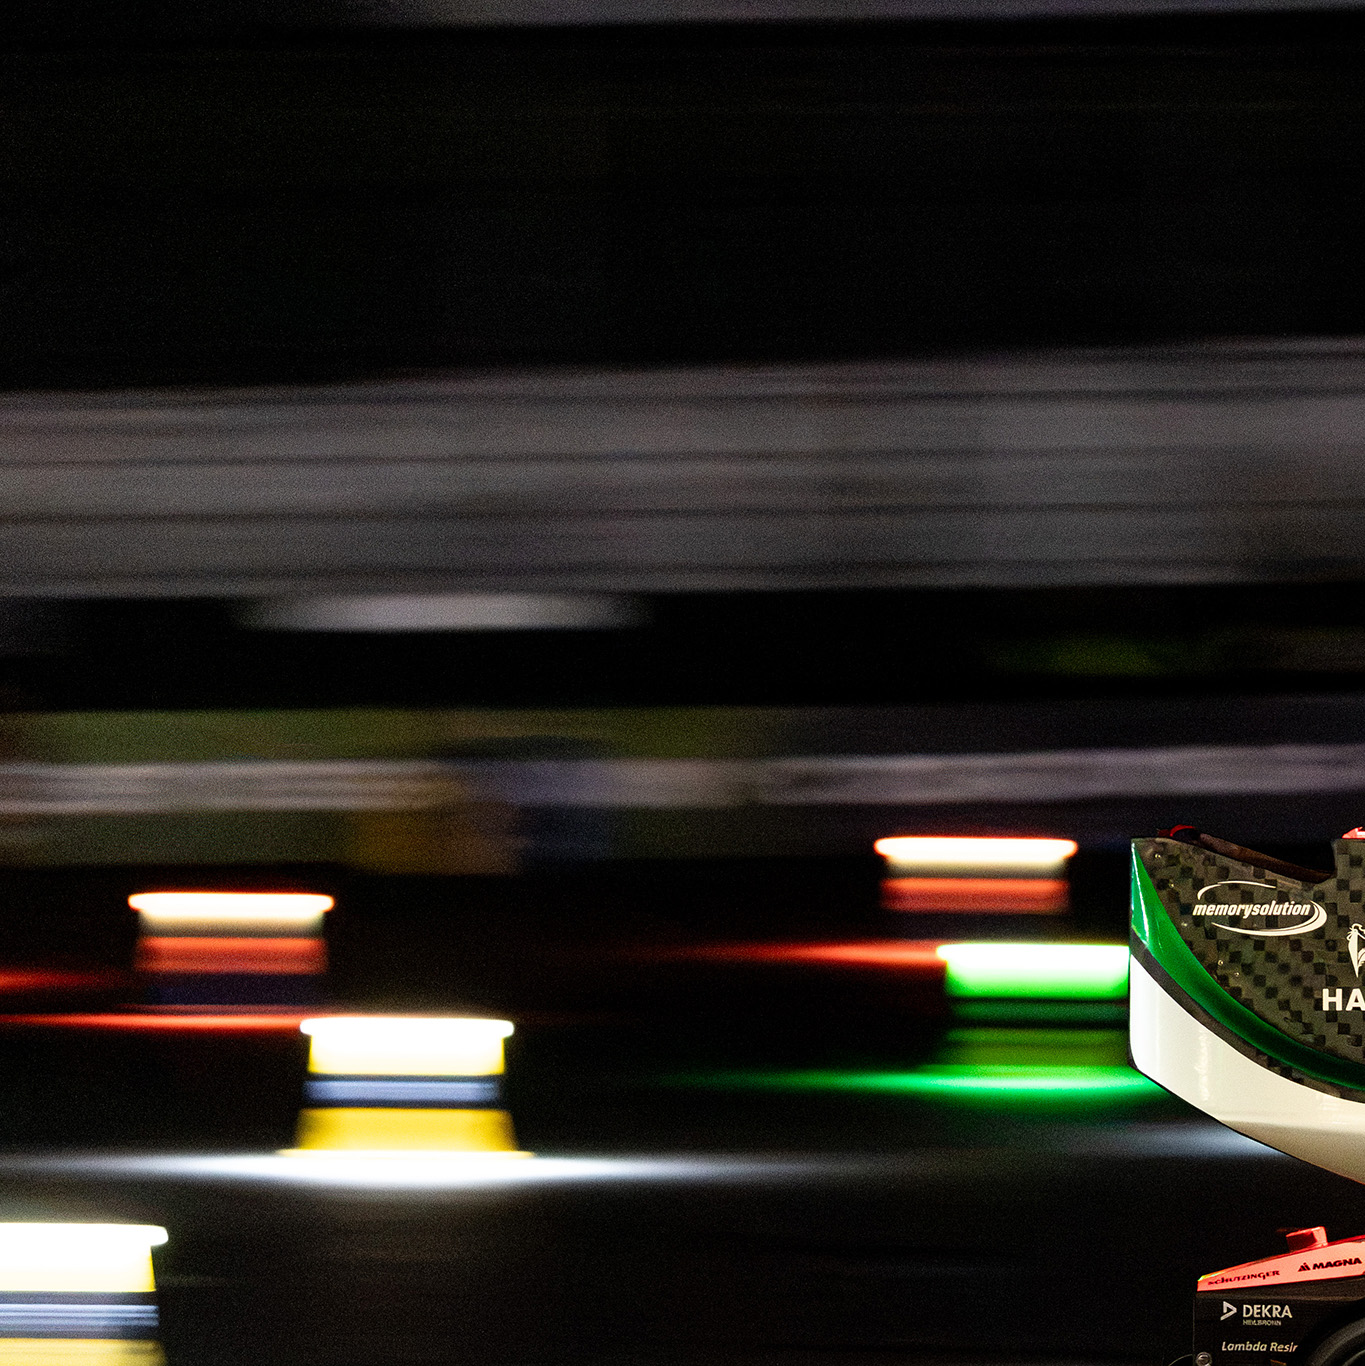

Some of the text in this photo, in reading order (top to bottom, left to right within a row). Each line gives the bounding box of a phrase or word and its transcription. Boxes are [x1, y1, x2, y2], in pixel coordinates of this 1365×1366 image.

[1192, 901, 1311, 918] memorysolution
[1312, 1257, 1363, 1270] MAGNA
[1242, 1304, 1293, 1319] DEKRA
[1221, 1341, 1267, 1352] Lambda
